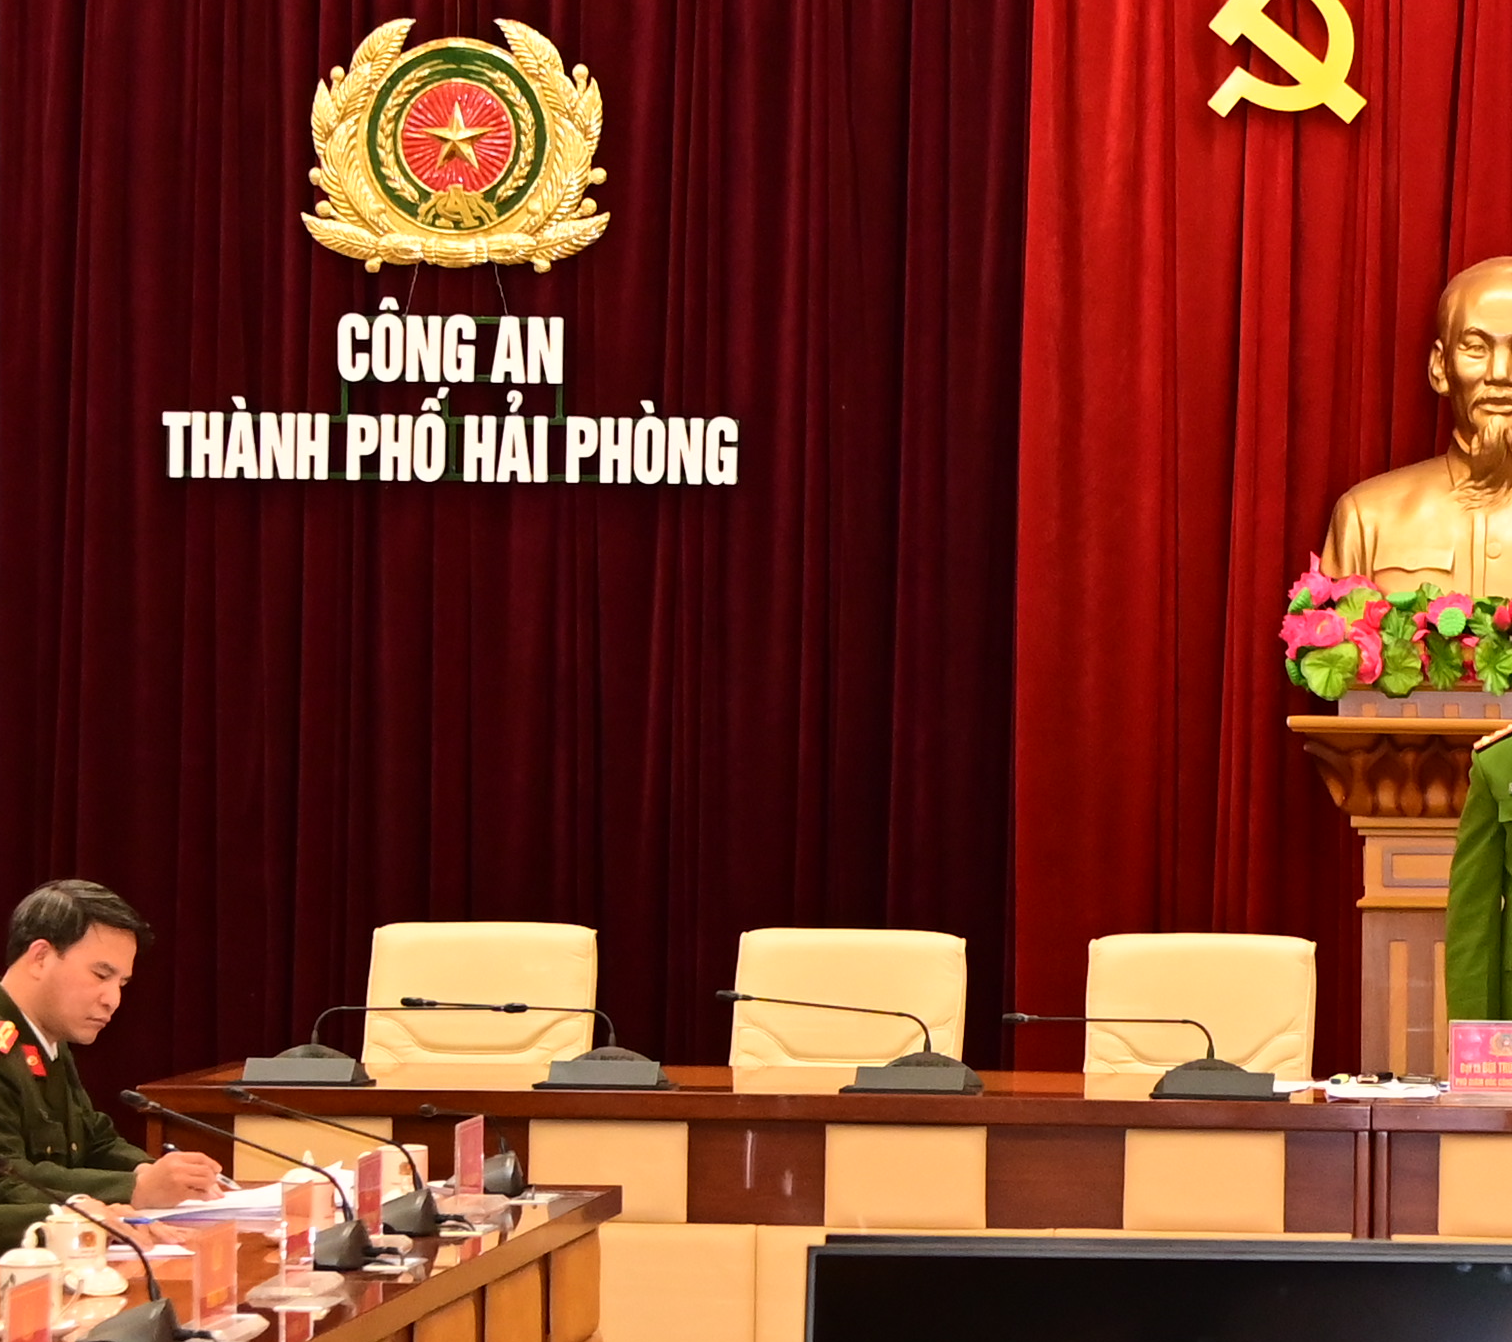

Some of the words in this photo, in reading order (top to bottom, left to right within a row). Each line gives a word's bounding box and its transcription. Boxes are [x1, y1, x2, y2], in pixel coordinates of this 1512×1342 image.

[337, 296, 477, 384] CÔNG
[489, 315, 565, 385] AN
[161, 395, 331, 481] THÀNH
[345, 386, 450, 483] PHỐ
[462, 389, 549, 484] HẢI
[564, 399, 739, 486] PHÒNG
